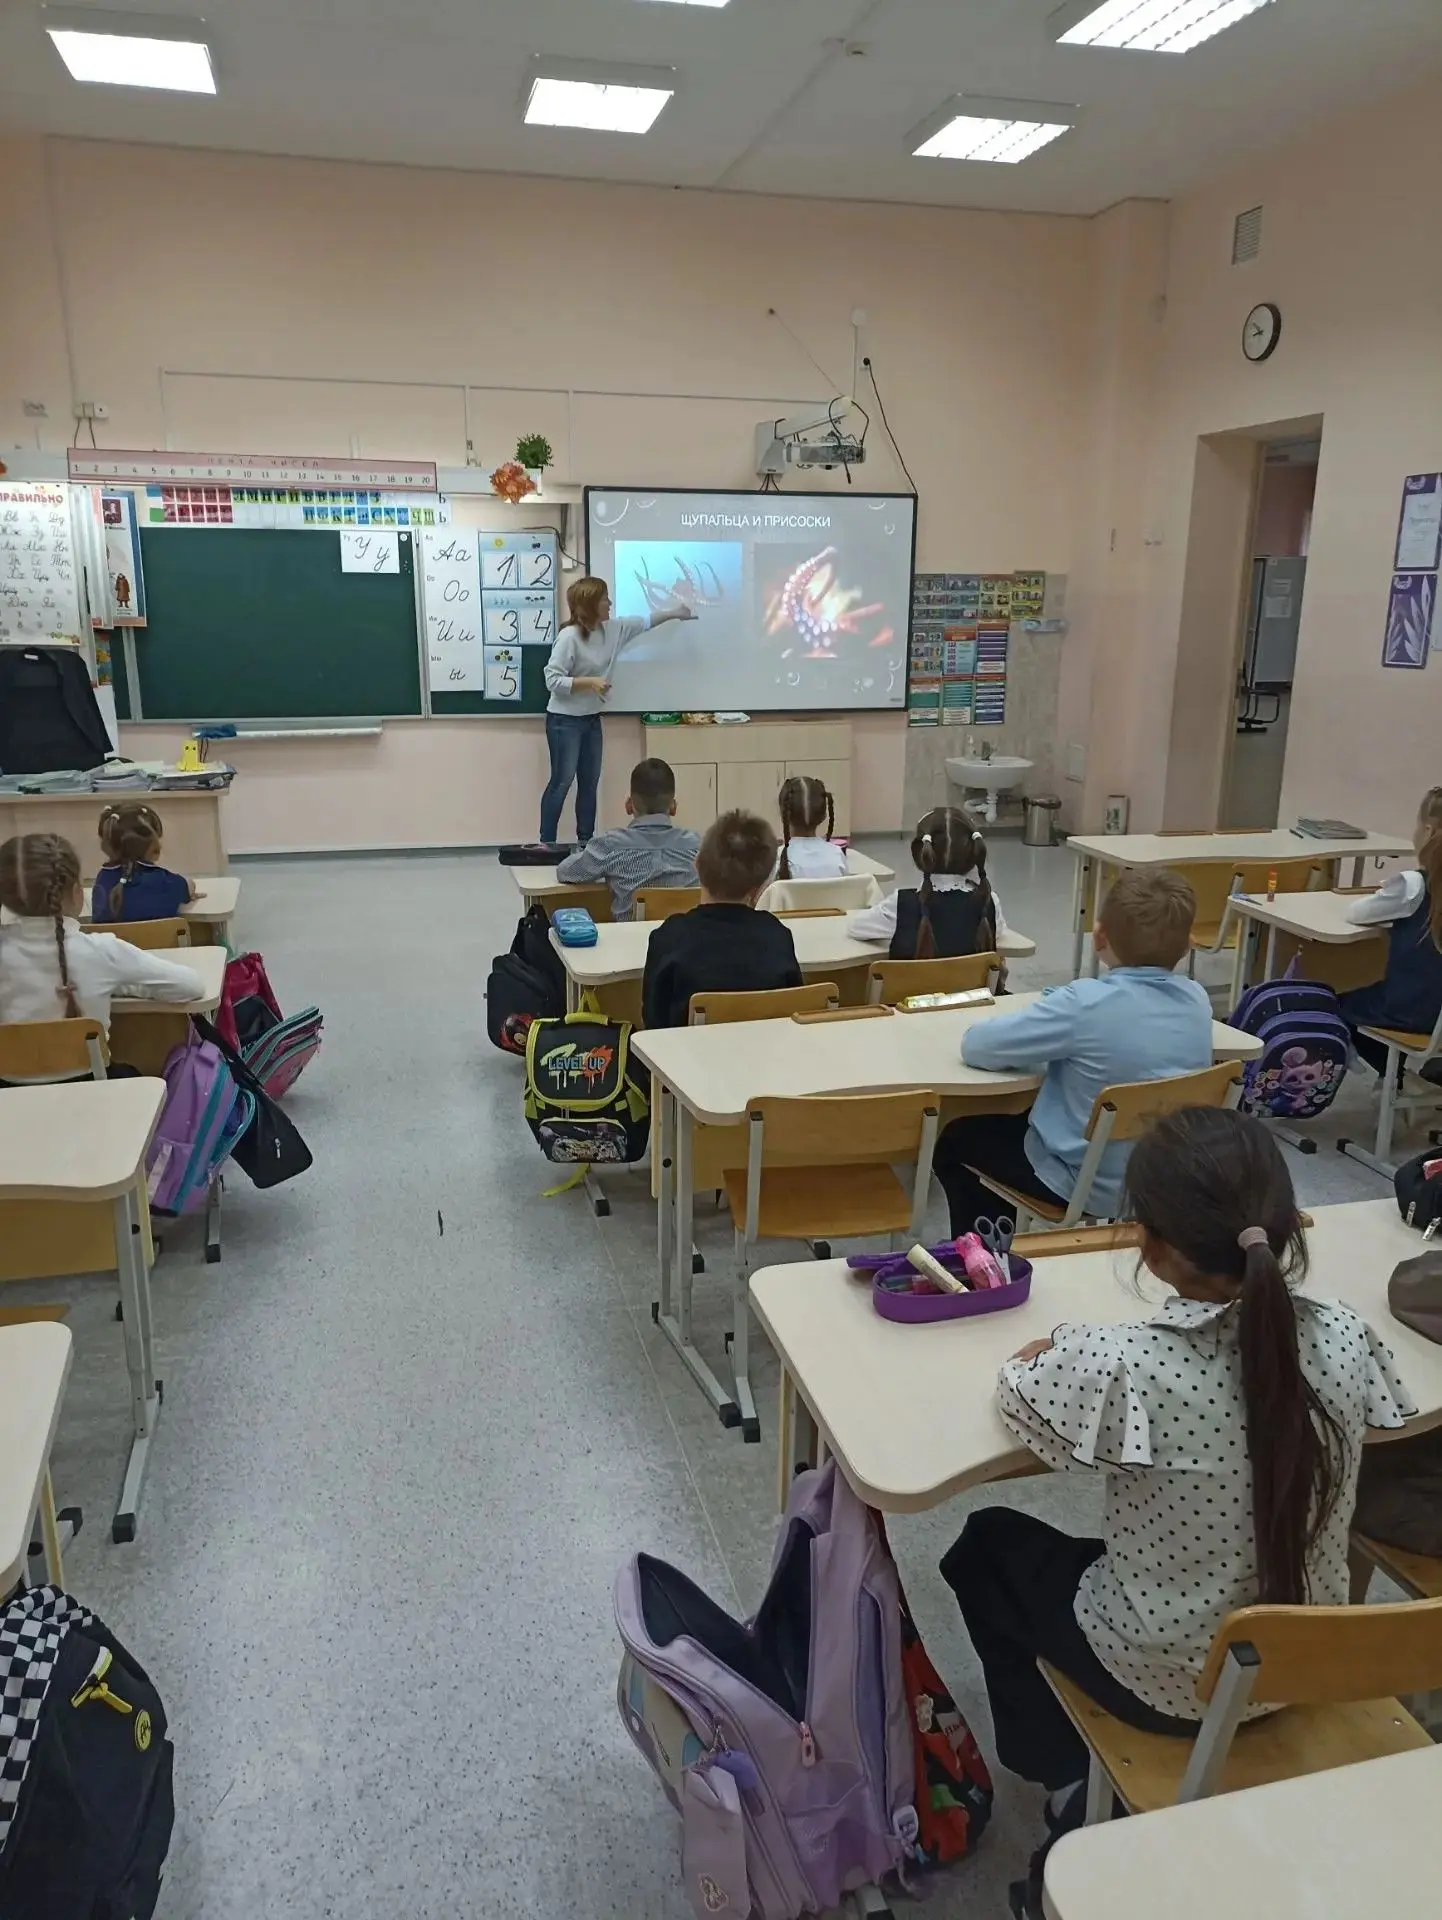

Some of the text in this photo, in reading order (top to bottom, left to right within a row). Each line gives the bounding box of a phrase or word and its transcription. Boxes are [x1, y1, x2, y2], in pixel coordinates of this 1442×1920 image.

[681, 513, 831, 528] ЩУПАЛЬЦА И ПРИСОСКИ
[432, 540, 472, 562] Аа
[497, 553, 552, 586] 1 2
[443, 579, 470, 602] Оо
[499, 610, 551, 642] 3 4
[499, 665, 518, 697] 5
[548, 1056, 605, 1070] LEVEL UP
